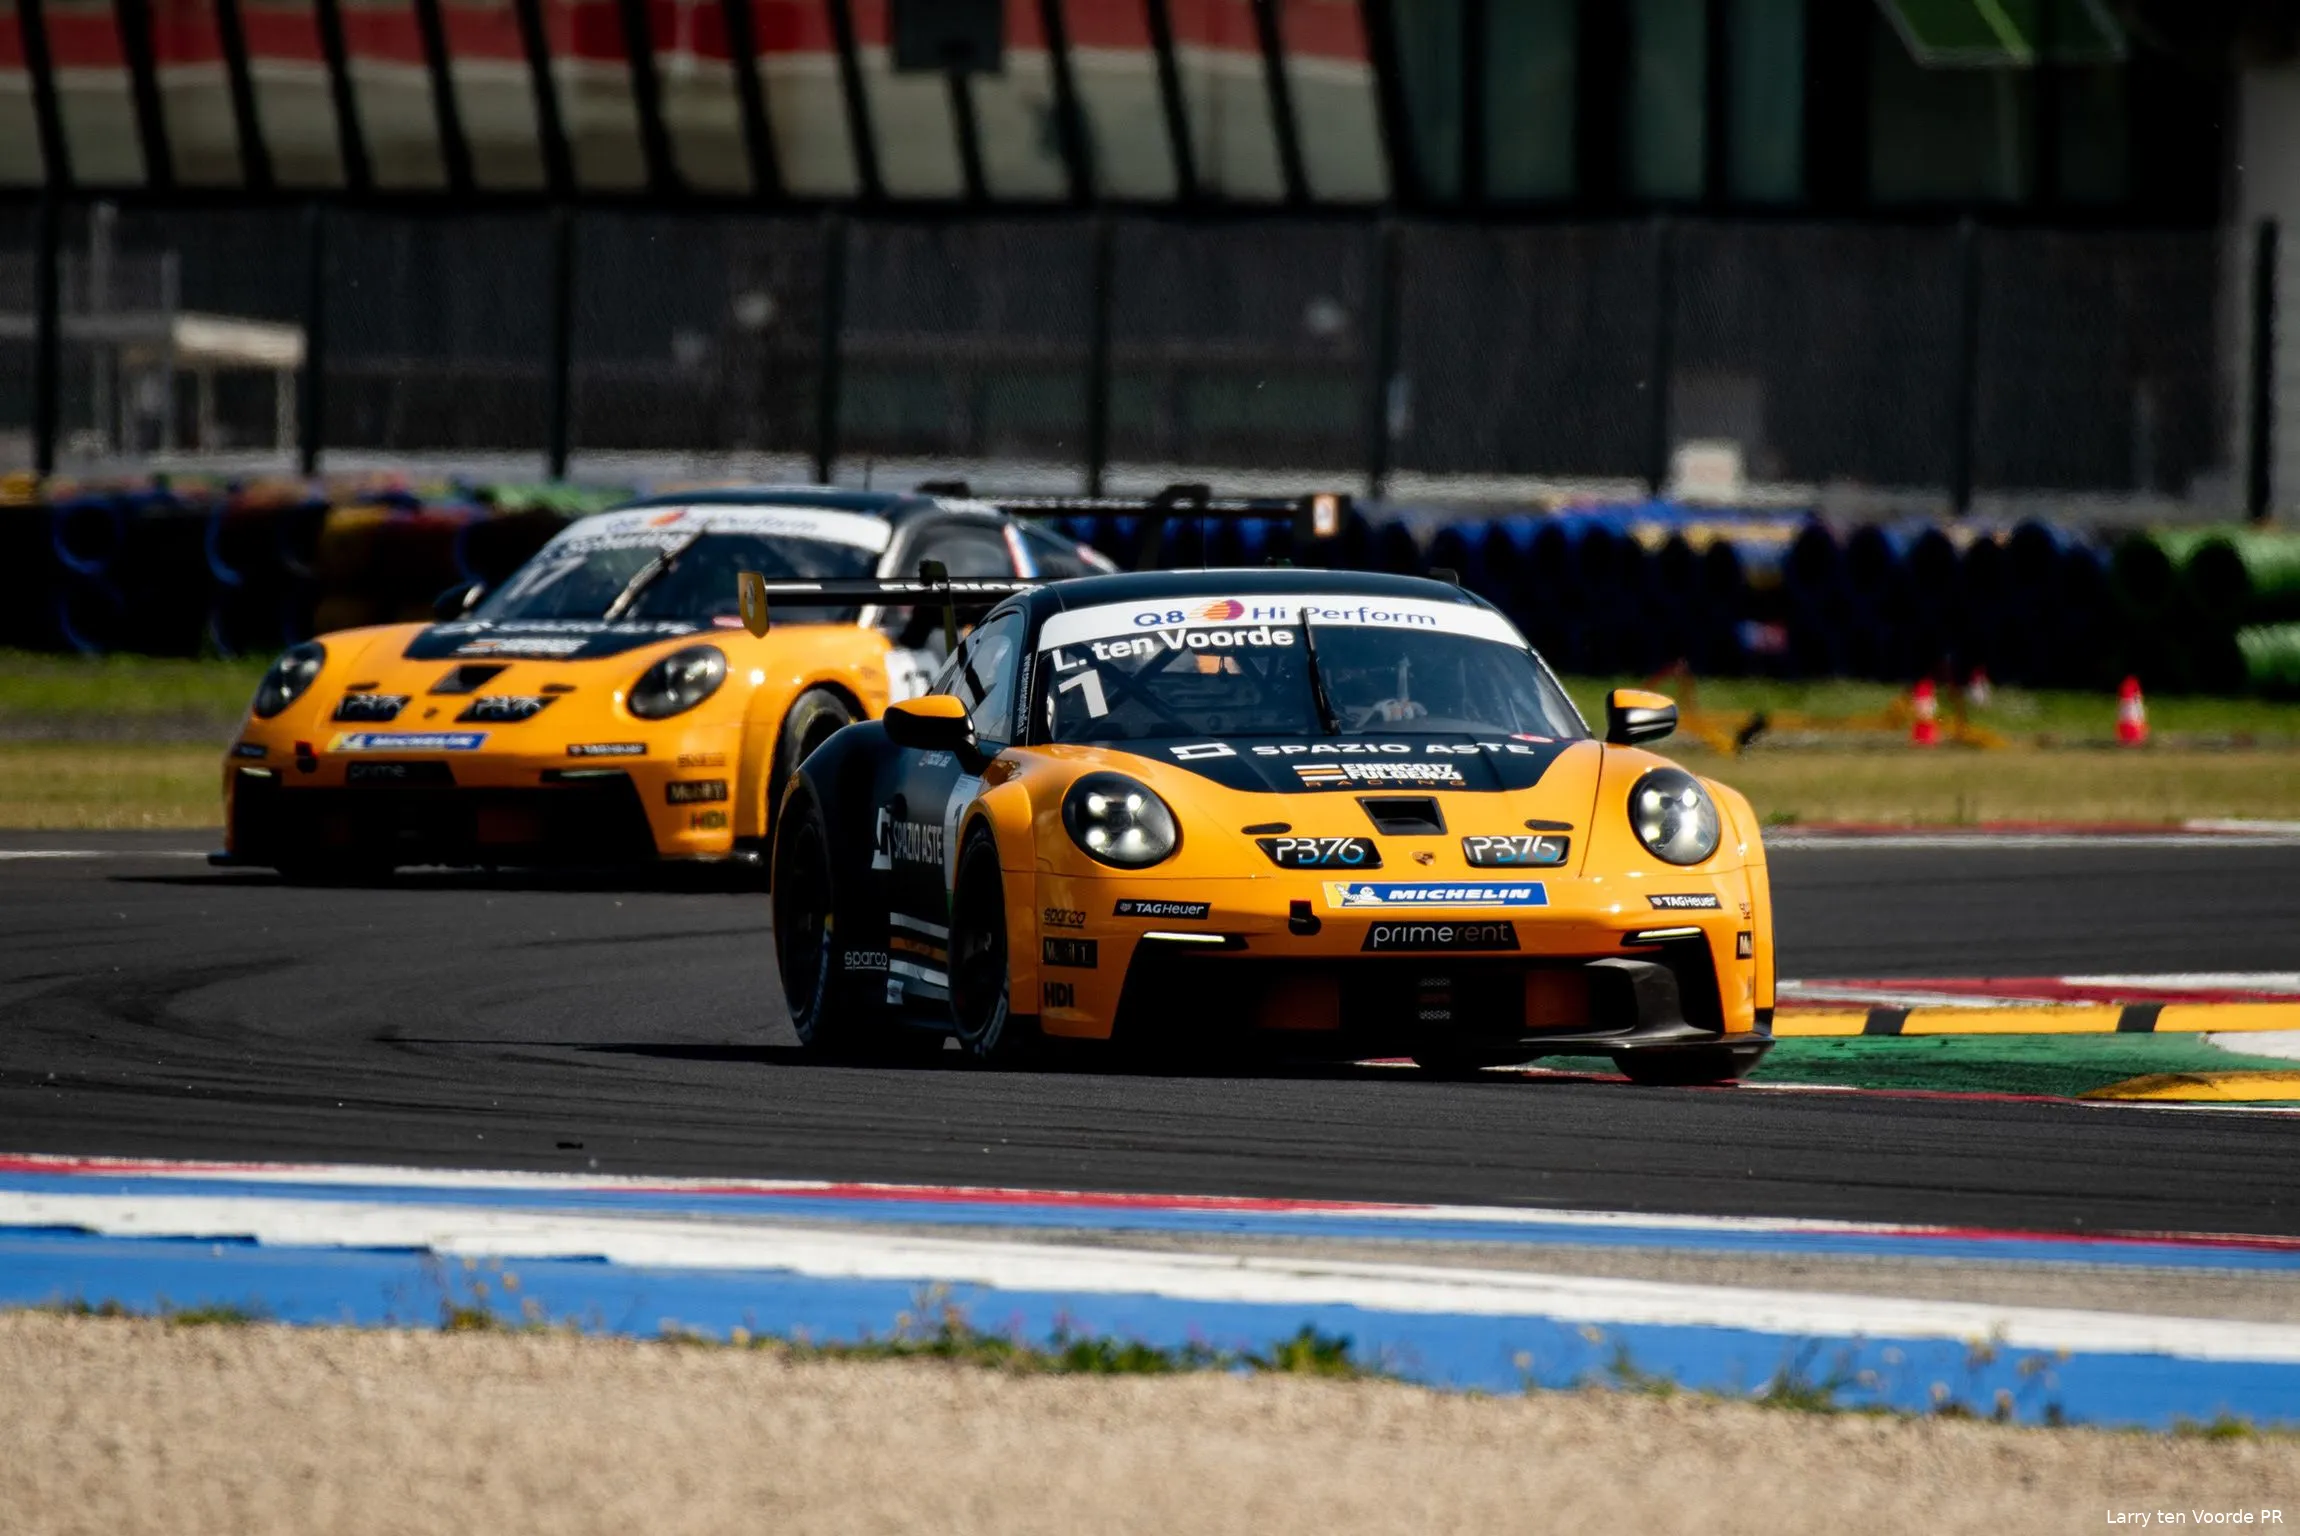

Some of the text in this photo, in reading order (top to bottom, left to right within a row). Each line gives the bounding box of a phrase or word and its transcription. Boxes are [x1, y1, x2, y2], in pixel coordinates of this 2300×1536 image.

[1133, 606, 1437, 627] Q8 Hi Perform
[1052, 626, 1295, 672] L. ten Voorde
[1058, 669, 1109, 719] 1
[1251, 743, 1535, 755] SPAZIO ASTE
[1304, 780, 1467, 788] RACING
[893, 821, 943, 864] SPAZIO ASTE
[1388, 889, 1532, 900] MICHELIN
[1044, 907, 1087, 925] sparco
[1373, 923, 1509, 948] primerent
[844, 951, 888, 971] sparco
